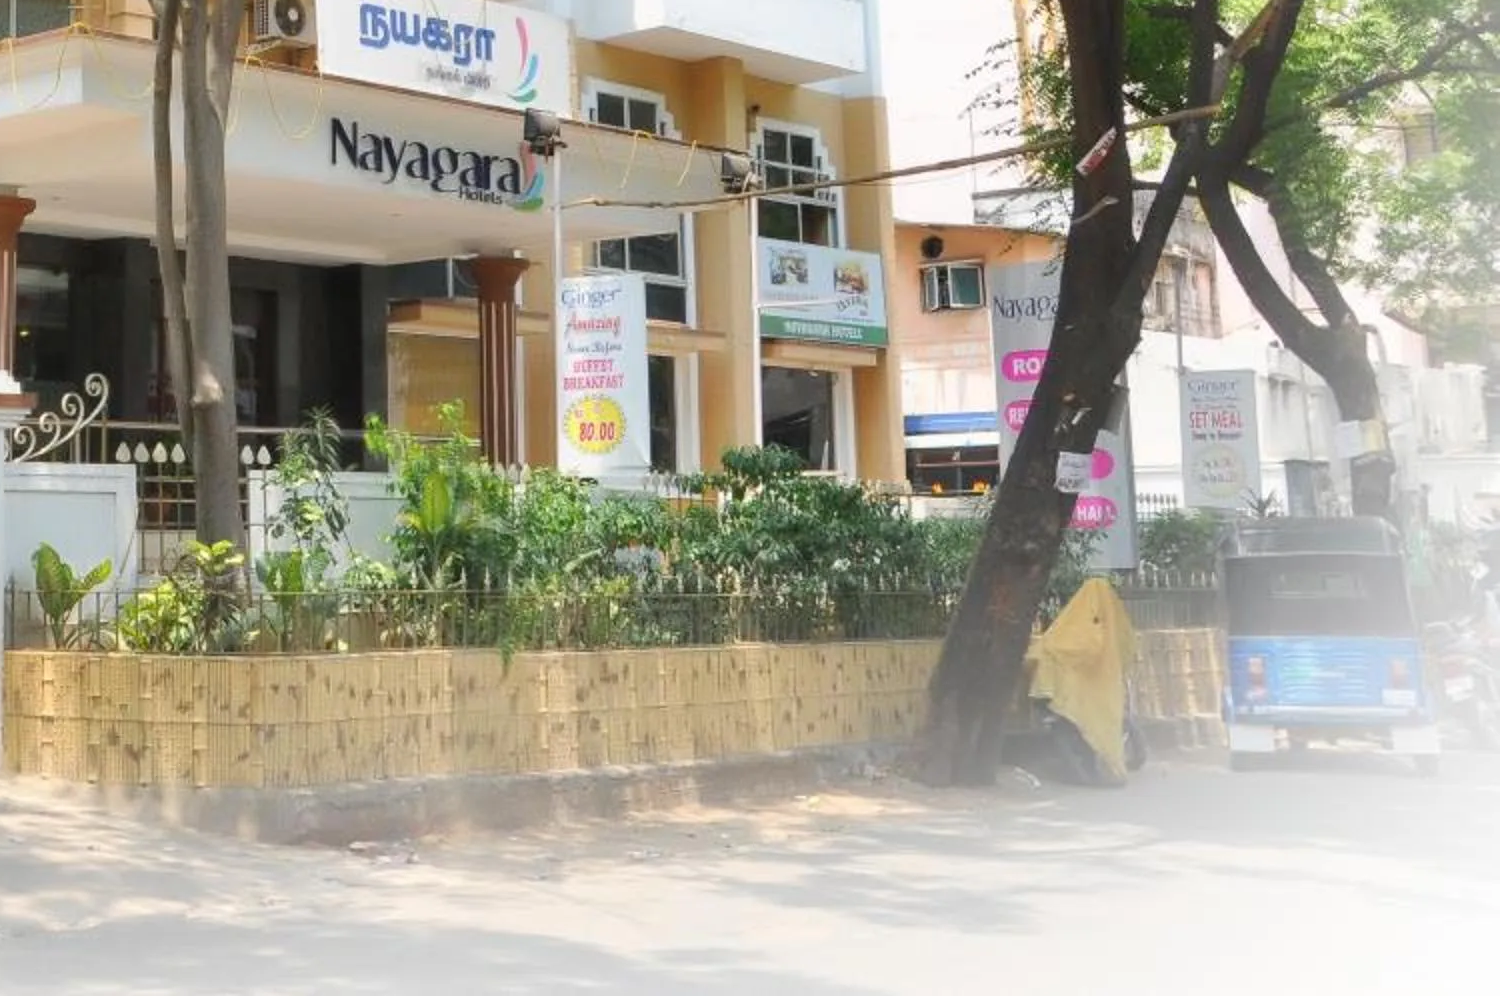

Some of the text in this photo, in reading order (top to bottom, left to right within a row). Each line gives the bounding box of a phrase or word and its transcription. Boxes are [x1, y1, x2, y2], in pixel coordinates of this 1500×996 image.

[359, 3, 496, 65] நயகரா
[330, 117, 521, 194] Nayagara
[459, 185, 503, 204] Hotels
[562, 288, 622, 309] Ginger
[564, 311, 621, 337] Amazing
[573, 359, 613, 373] BUFFET
[563, 374, 625, 390] BREAKFAST
[1189, 411, 1242, 429] SET MEAL
[579, 421, 615, 442] 80.00
